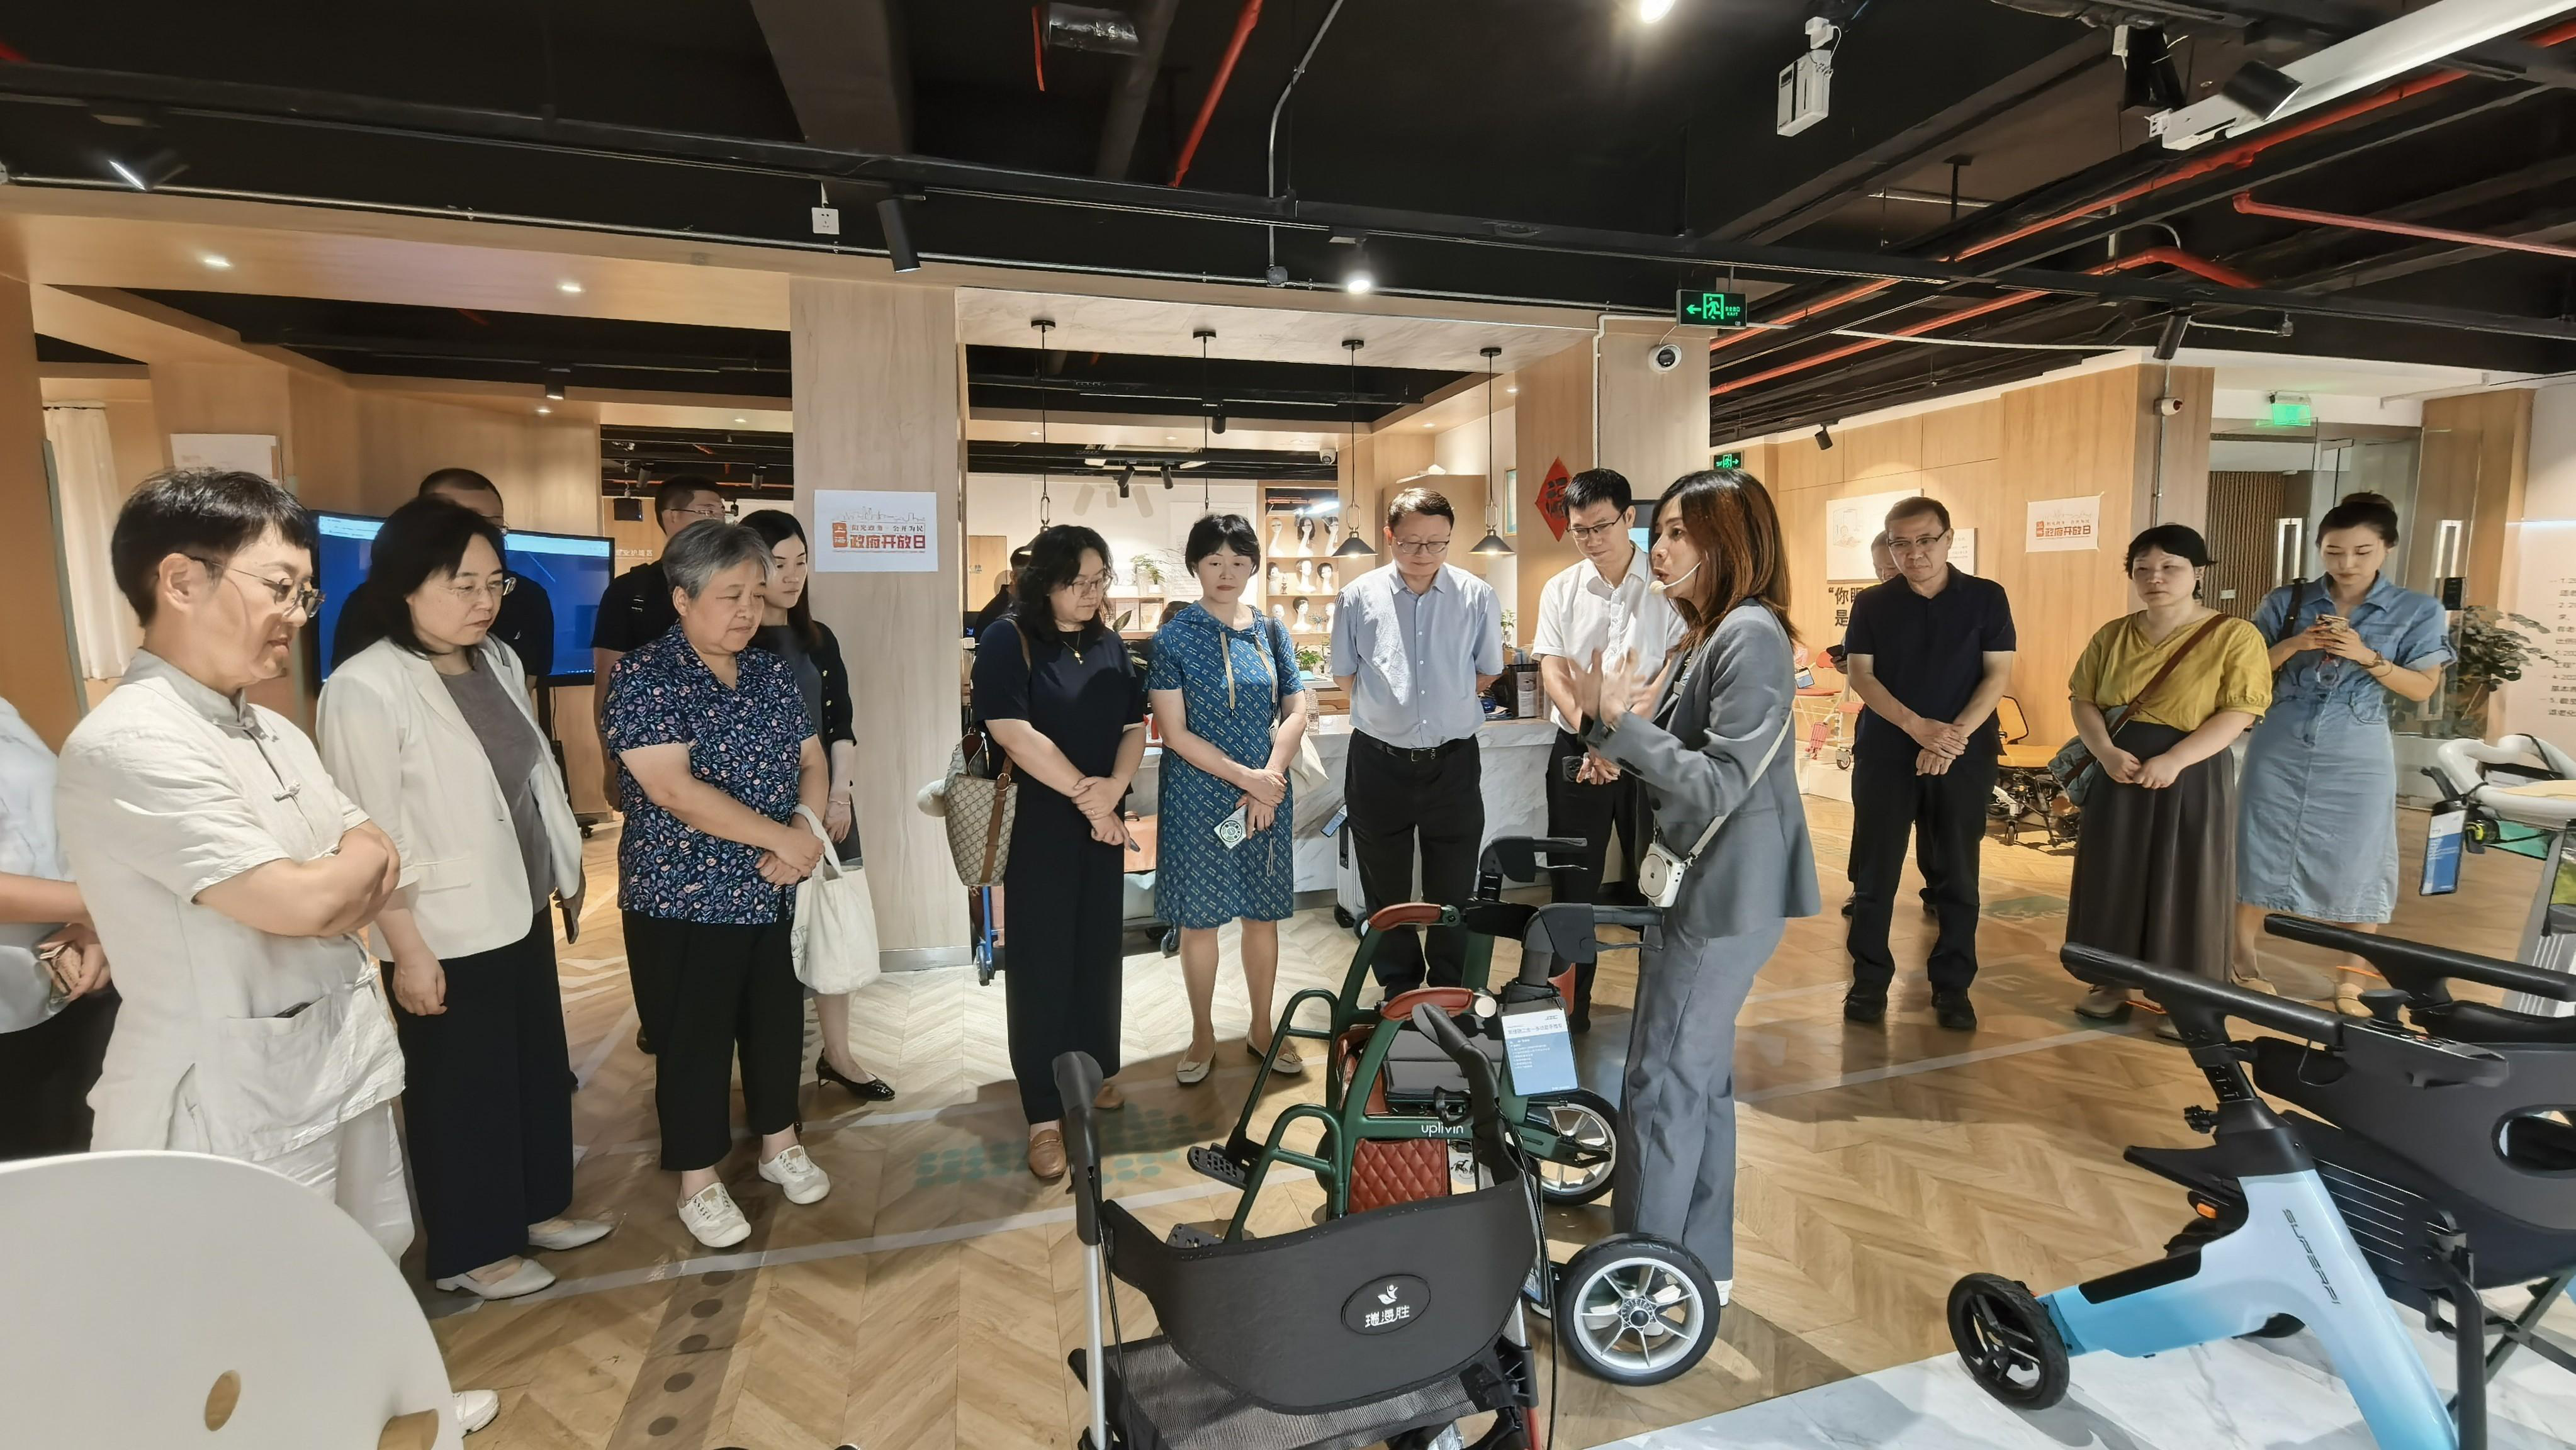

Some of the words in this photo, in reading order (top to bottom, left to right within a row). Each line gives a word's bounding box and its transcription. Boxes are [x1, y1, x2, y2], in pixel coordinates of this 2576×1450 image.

[2045, 525, 2091, 537] 政府开放日
[850, 535, 926, 549] 政府开放日
[1835, 609, 1848, 626] 是
[1421, 1121, 1463, 1137] uplivin
